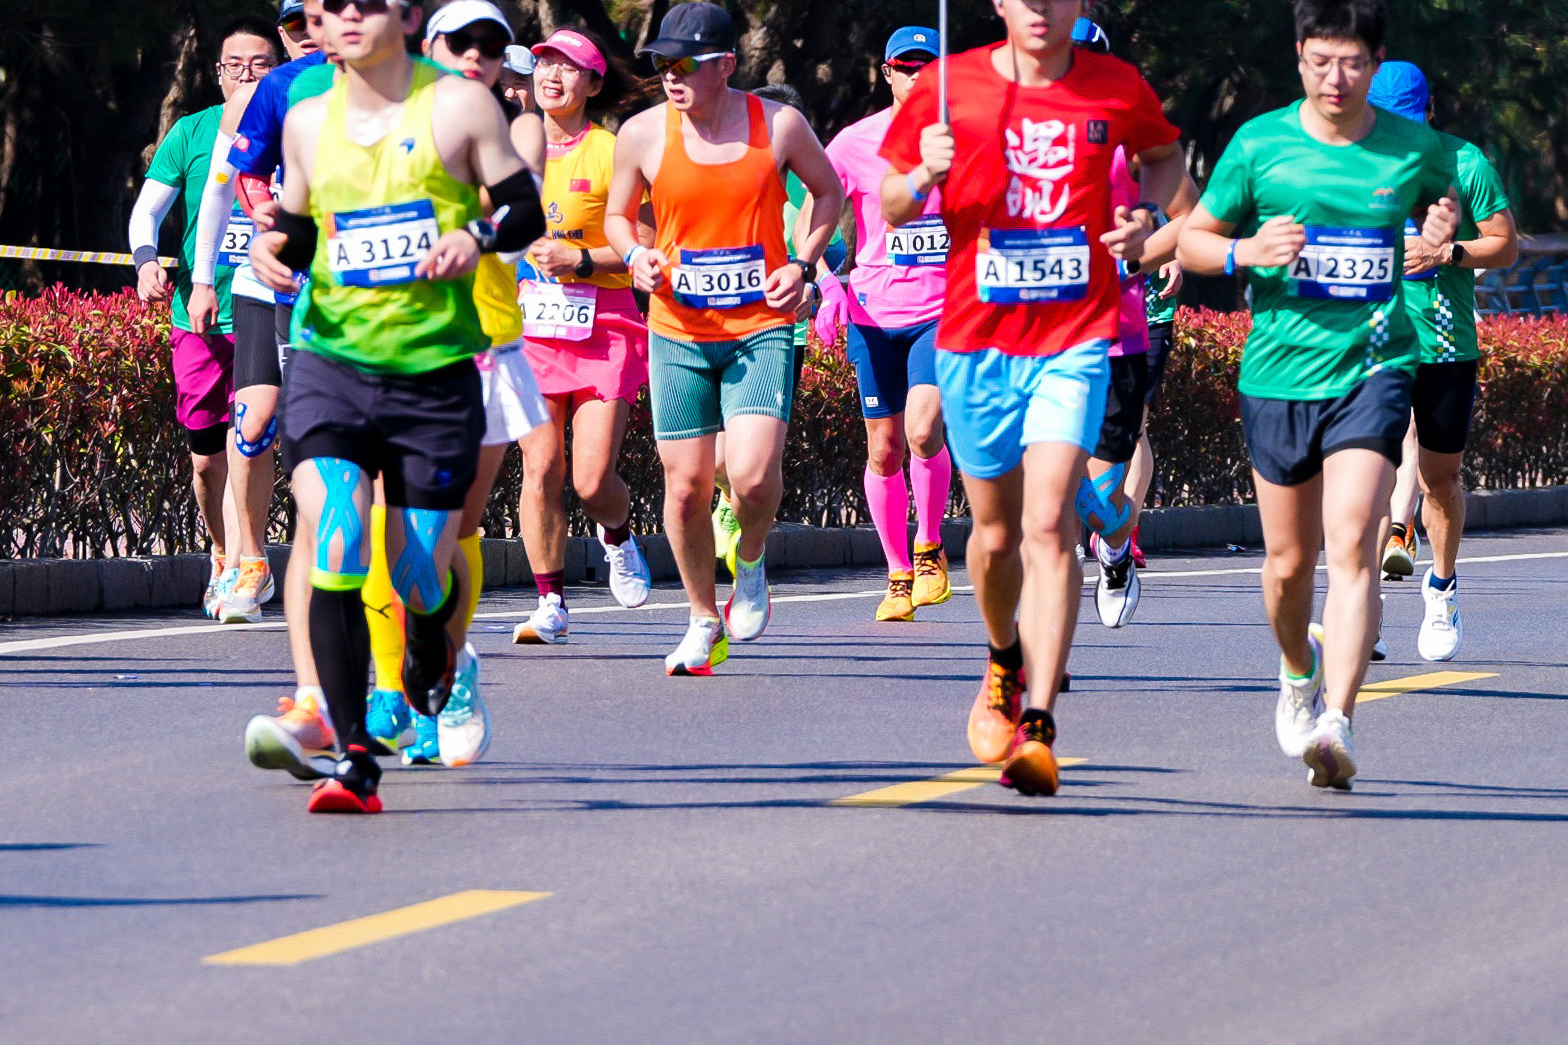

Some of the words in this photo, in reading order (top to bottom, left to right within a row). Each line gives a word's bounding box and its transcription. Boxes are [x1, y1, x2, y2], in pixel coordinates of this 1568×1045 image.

[225, 232, 251, 251] 32
[336, 243, 351, 266] A
[360, 231, 432, 264] 3124
[891, 235, 904, 252] A
[984, 259, 1000, 282] A
[1014, 258, 1083, 283] 1543
[1293, 257, 1312, 277] A
[1325, 257, 1389, 280] 2325
[676, 273, 692, 291] A
[702, 269, 761, 292] 3016
